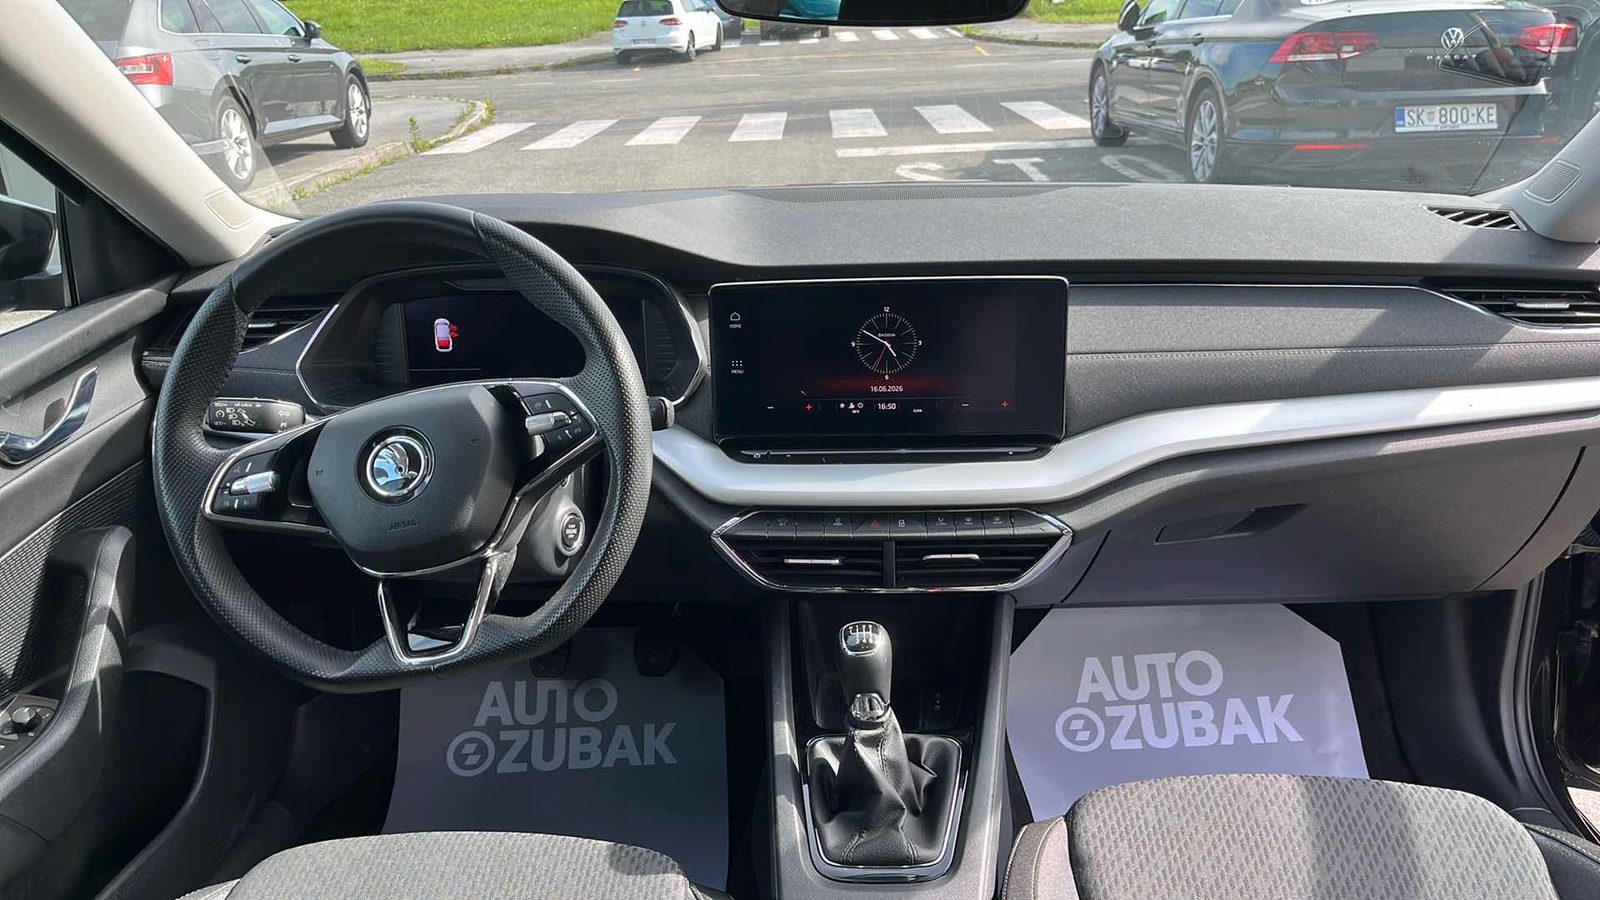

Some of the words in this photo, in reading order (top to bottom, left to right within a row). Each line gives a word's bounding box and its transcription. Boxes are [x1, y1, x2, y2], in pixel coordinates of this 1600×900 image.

[1406, 108, 1425, 126] SK
[1438, 106, 1495, 124] 800-KE
[878, 402, 897, 410] 16:50
[1075, 649, 1224, 703] AUTO
[473, 677, 618, 727] AUTO
[1104, 693, 1304, 750] ZUBAK
[496, 722, 678, 774] ZUBAK
